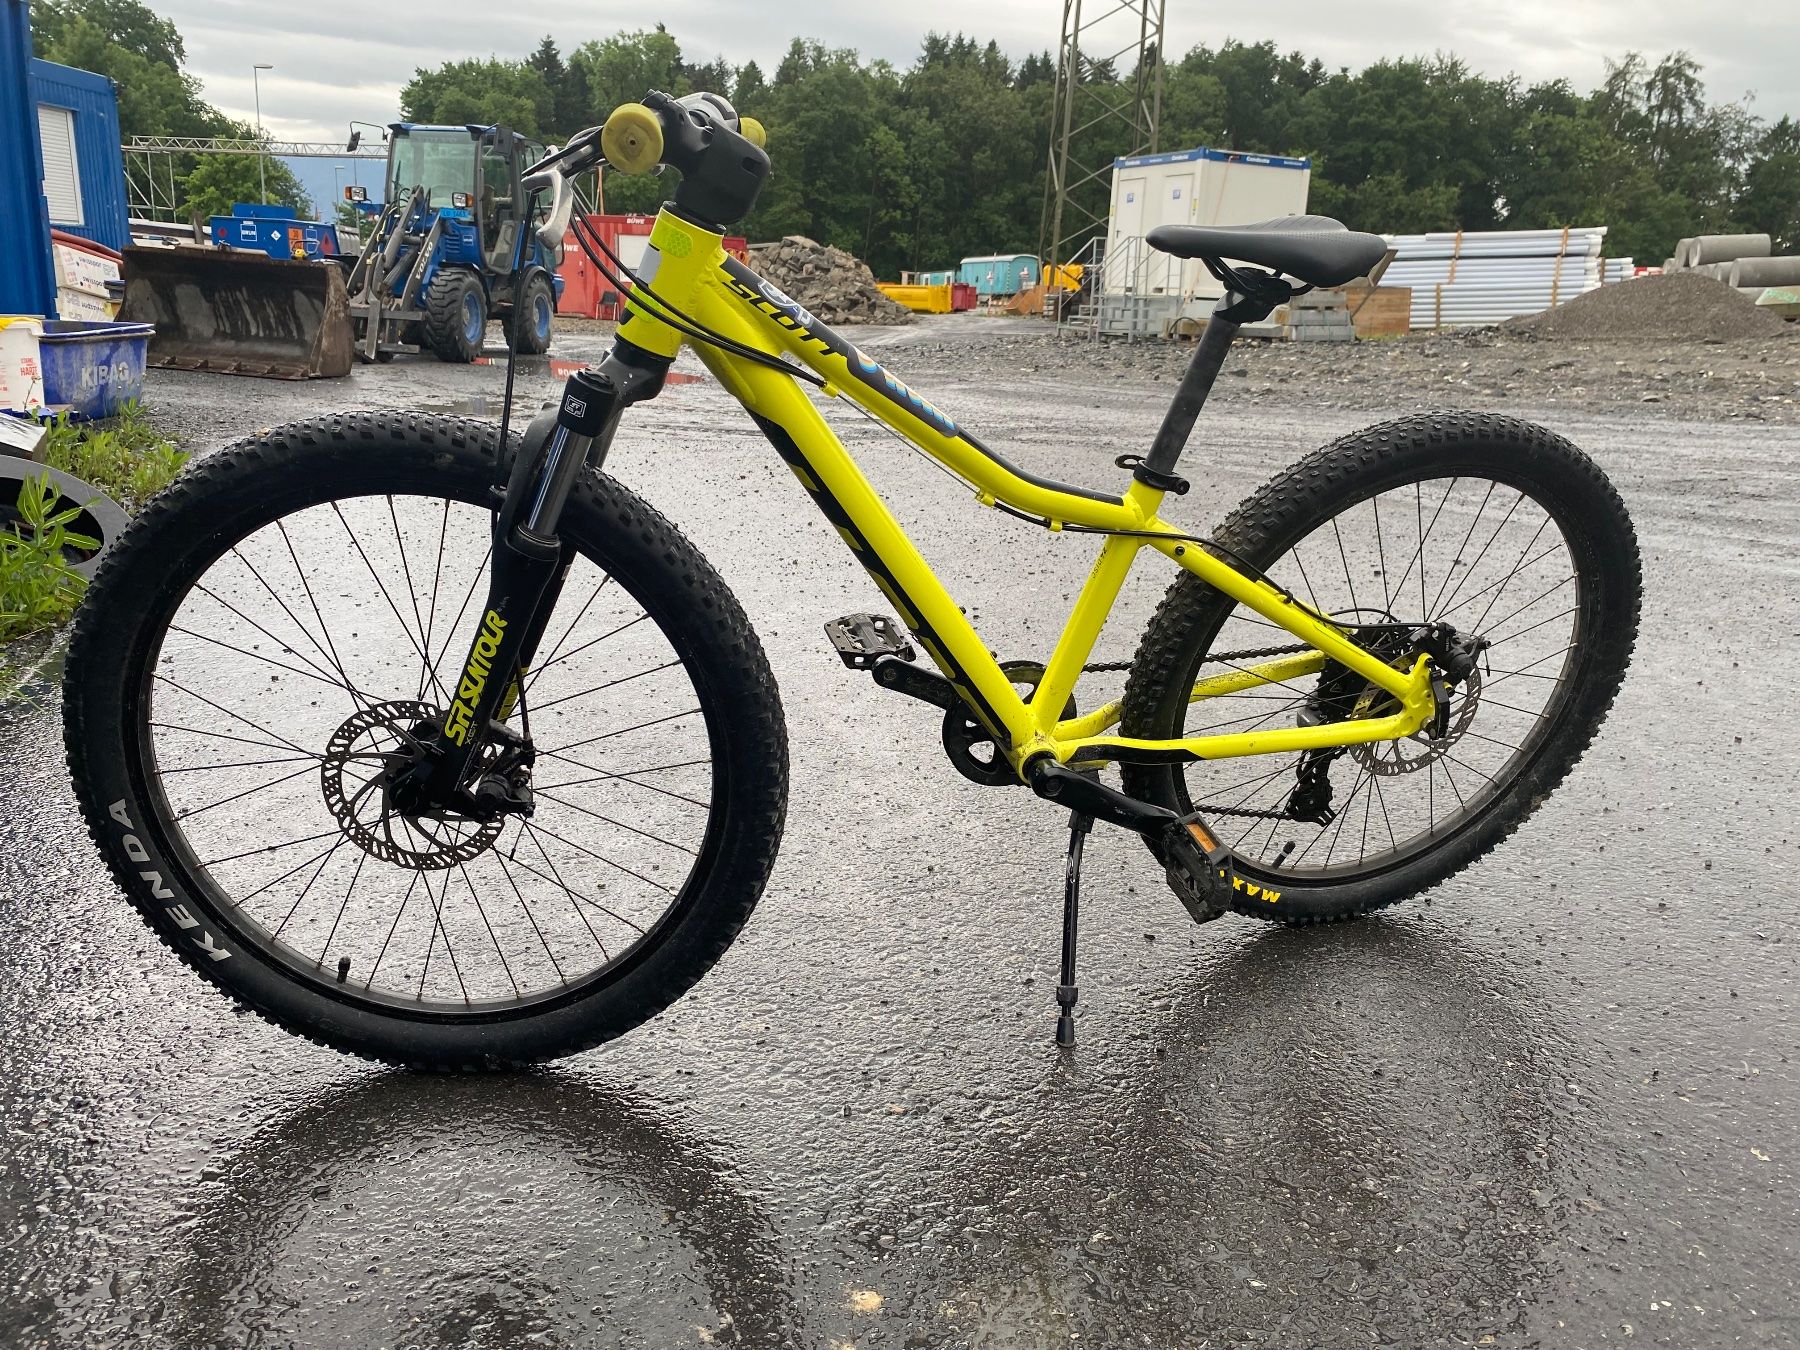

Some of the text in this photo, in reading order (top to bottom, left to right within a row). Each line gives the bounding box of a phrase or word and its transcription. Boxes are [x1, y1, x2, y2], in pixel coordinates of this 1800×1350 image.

[415, 241, 433, 280] VOLVO
[721, 279, 845, 357] SCOTT
[81, 360, 130, 391] KIBAG
[444, 698, 473, 747] SR
[459, 609, 508, 707] SUNTOUR
[108, 798, 233, 962] KENDA
